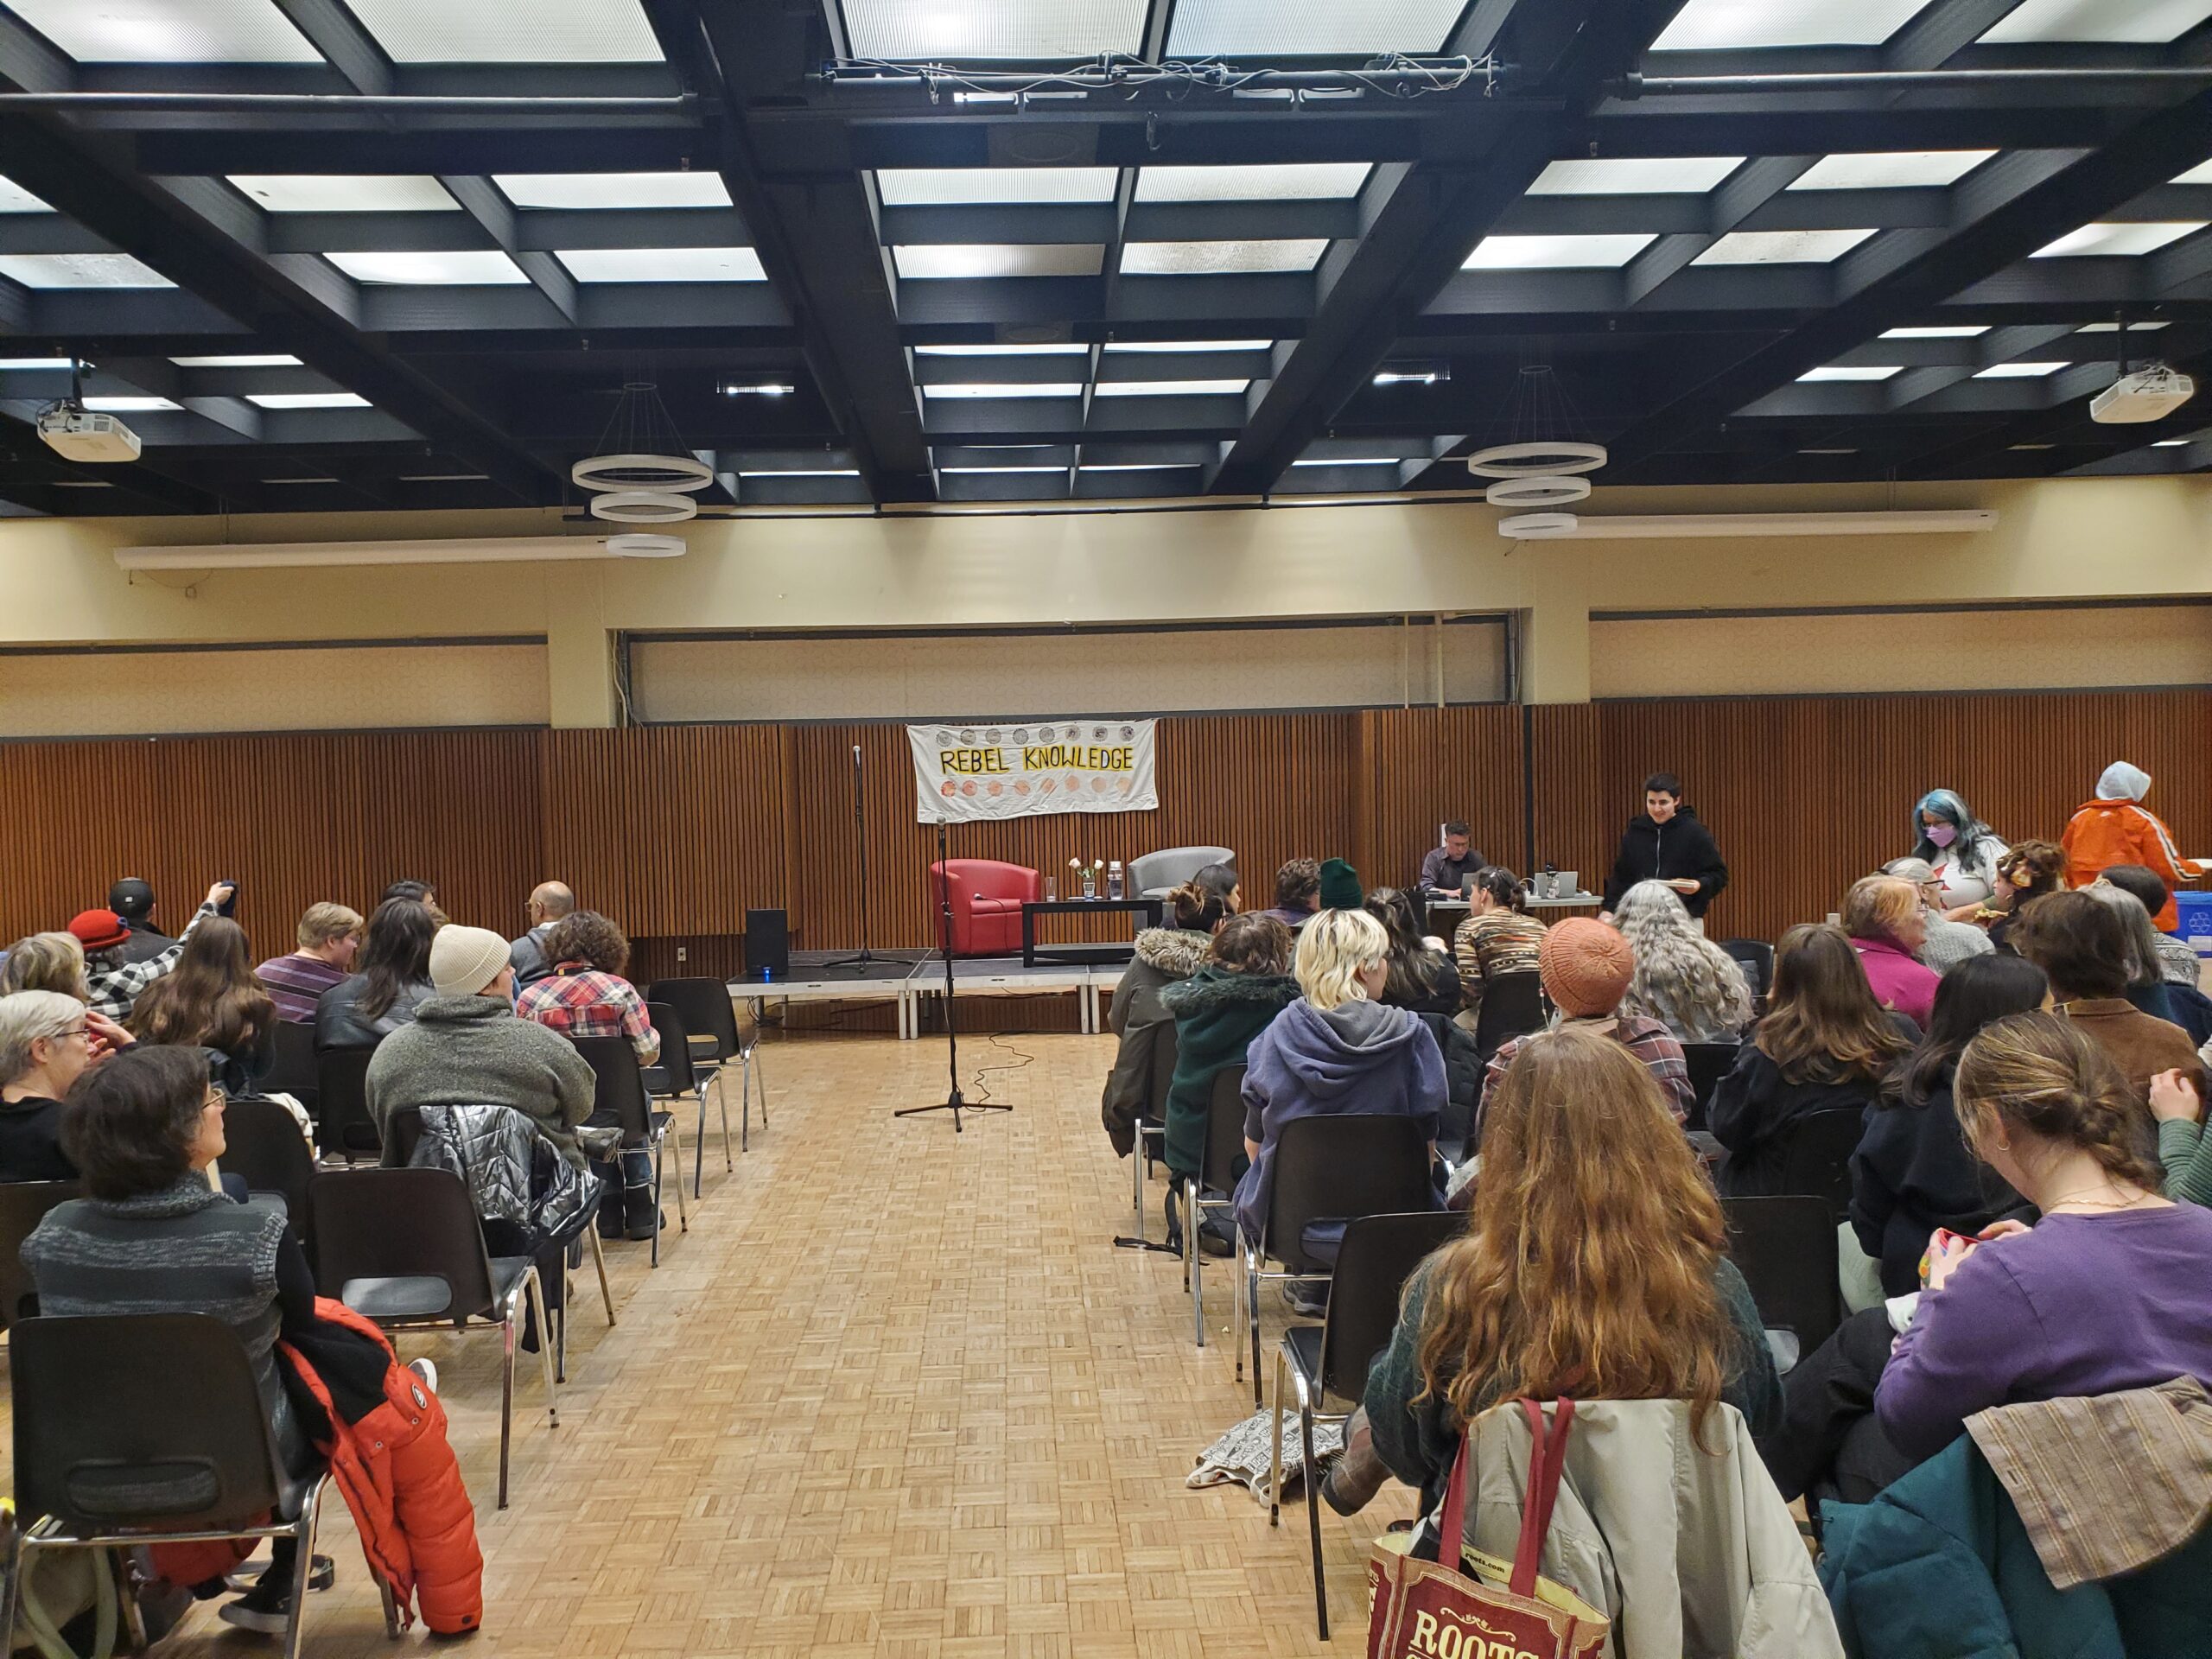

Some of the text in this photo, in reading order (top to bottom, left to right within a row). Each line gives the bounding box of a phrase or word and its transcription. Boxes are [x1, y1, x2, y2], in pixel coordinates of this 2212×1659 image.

[940, 745, 1134, 774] REBEL KNOWLEDGE
[1465, 1553, 1505, 1573] roots.com
[1409, 1609, 1539, 1659] ROOT
